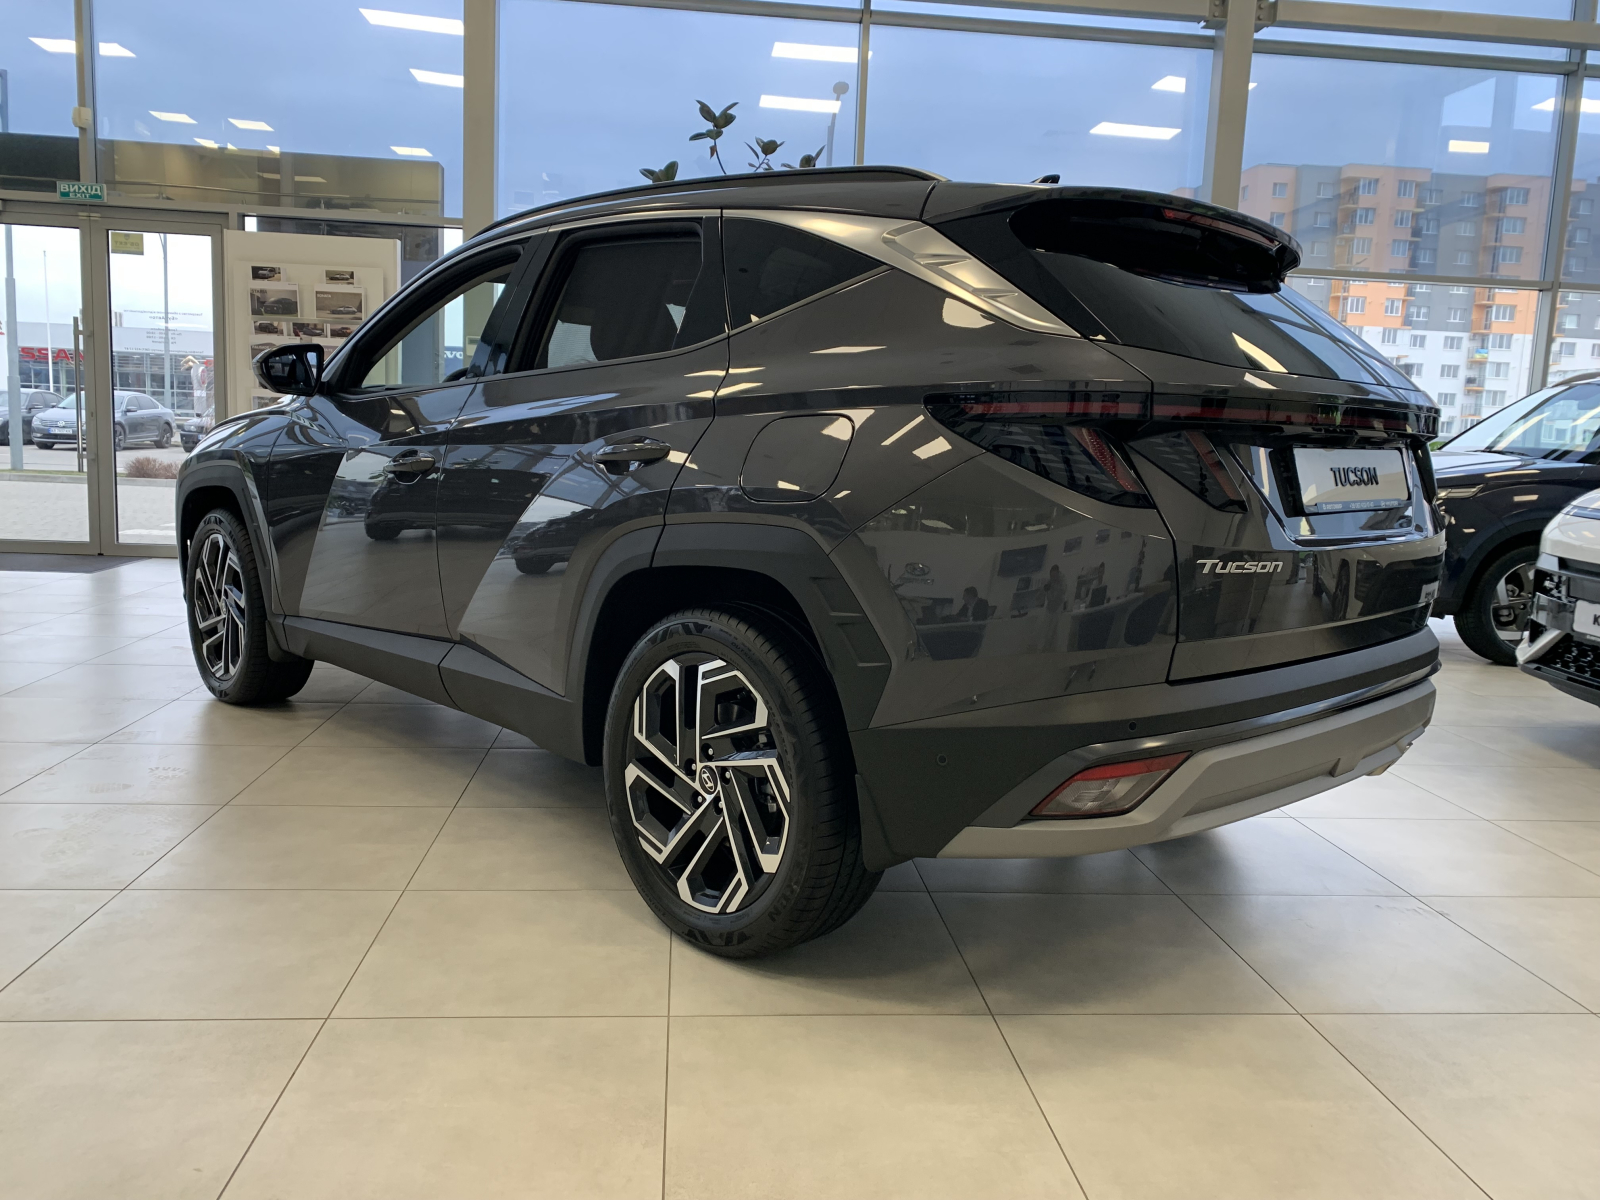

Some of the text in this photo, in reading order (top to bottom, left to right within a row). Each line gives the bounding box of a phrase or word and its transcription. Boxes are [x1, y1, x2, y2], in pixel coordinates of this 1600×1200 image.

[60, 184, 101, 195] ВИХІД
[1330, 466, 1379, 487] TUCSON
[1196, 559, 1284, 574] Tucson
